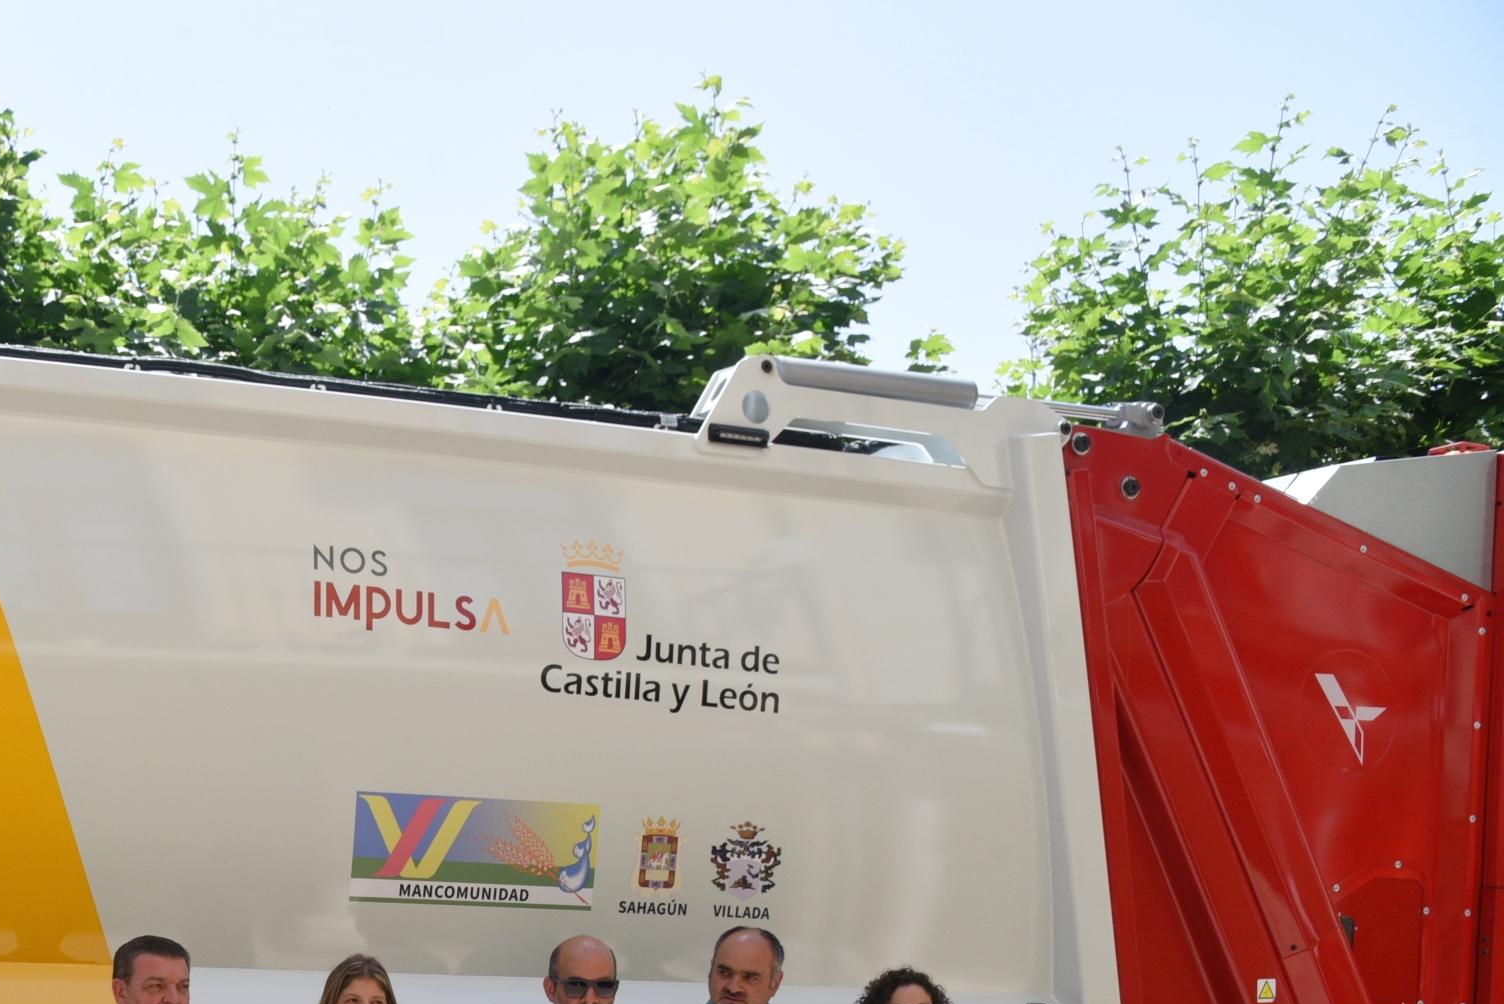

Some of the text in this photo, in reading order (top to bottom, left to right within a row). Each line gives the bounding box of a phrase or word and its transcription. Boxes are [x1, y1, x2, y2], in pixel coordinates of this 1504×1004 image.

[313, 543, 388, 577] NOS
[636, 634, 781, 675] Junta de
[540, 663, 780, 714] Castilla y León
[398, 883, 530, 902] MANCOMUNIDAD
[618, 899, 688, 917] SAHAGÚN
[713, 904, 770, 920] VILLADA
